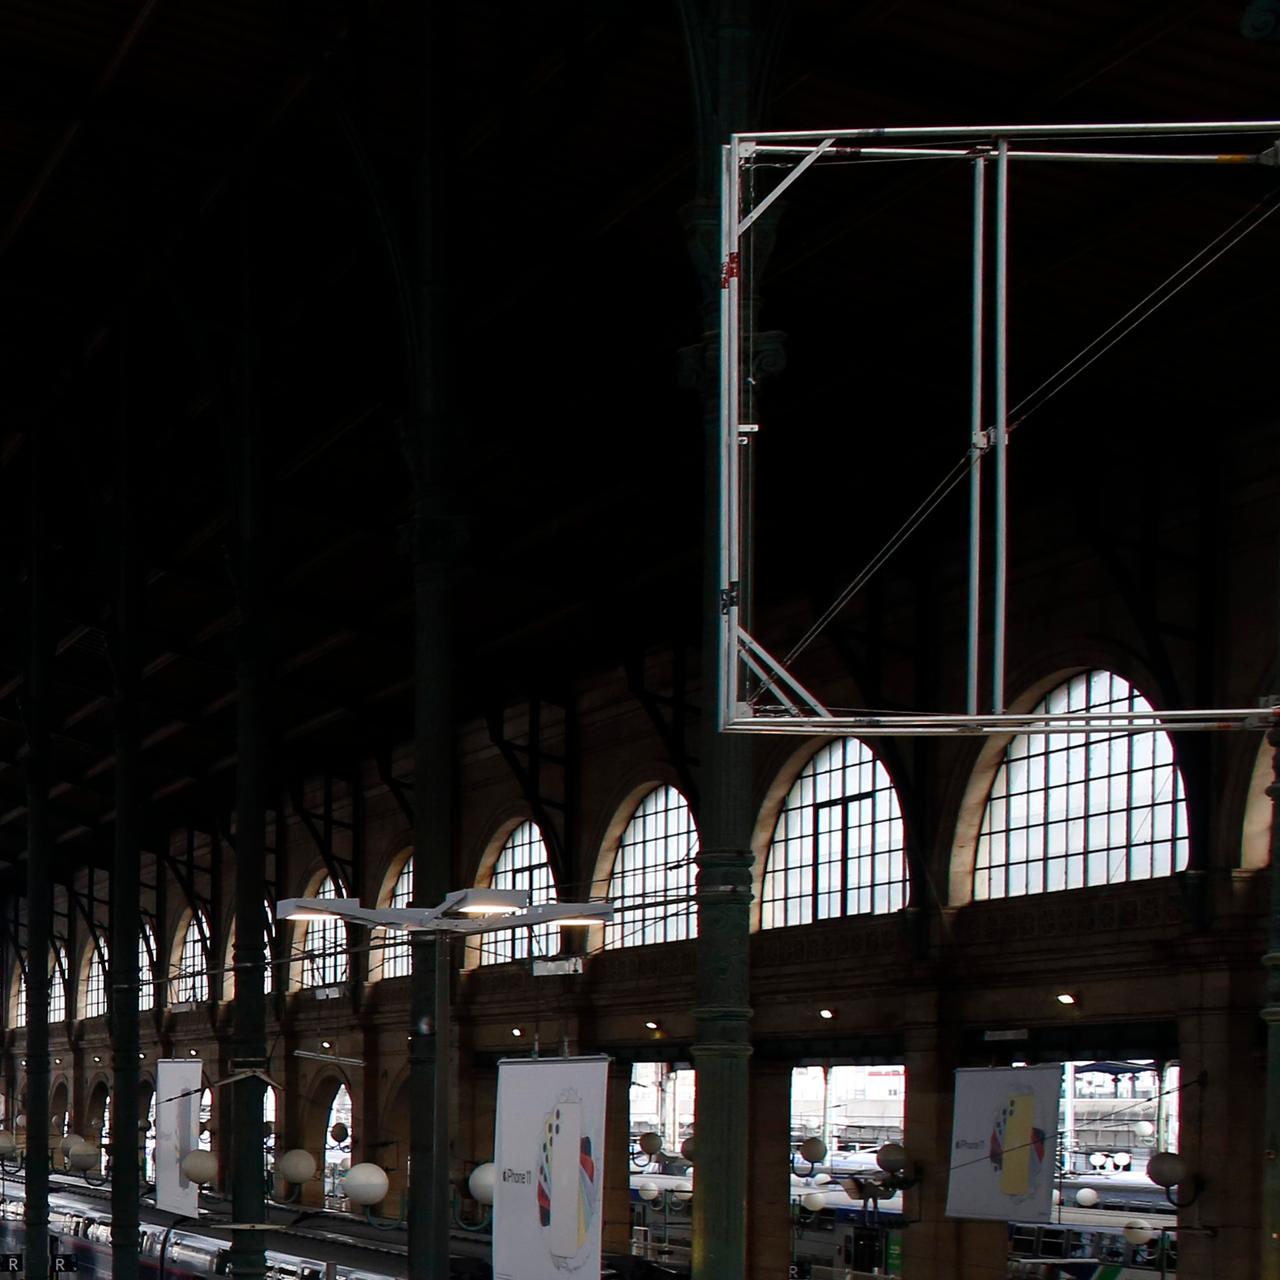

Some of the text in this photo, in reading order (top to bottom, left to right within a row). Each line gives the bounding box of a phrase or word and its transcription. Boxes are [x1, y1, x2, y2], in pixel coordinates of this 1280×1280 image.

[506, 1168, 532, 1184] iPhone 11
[8, 1256, 18, 1272] R
[54, 1256, 64, 1272] R
